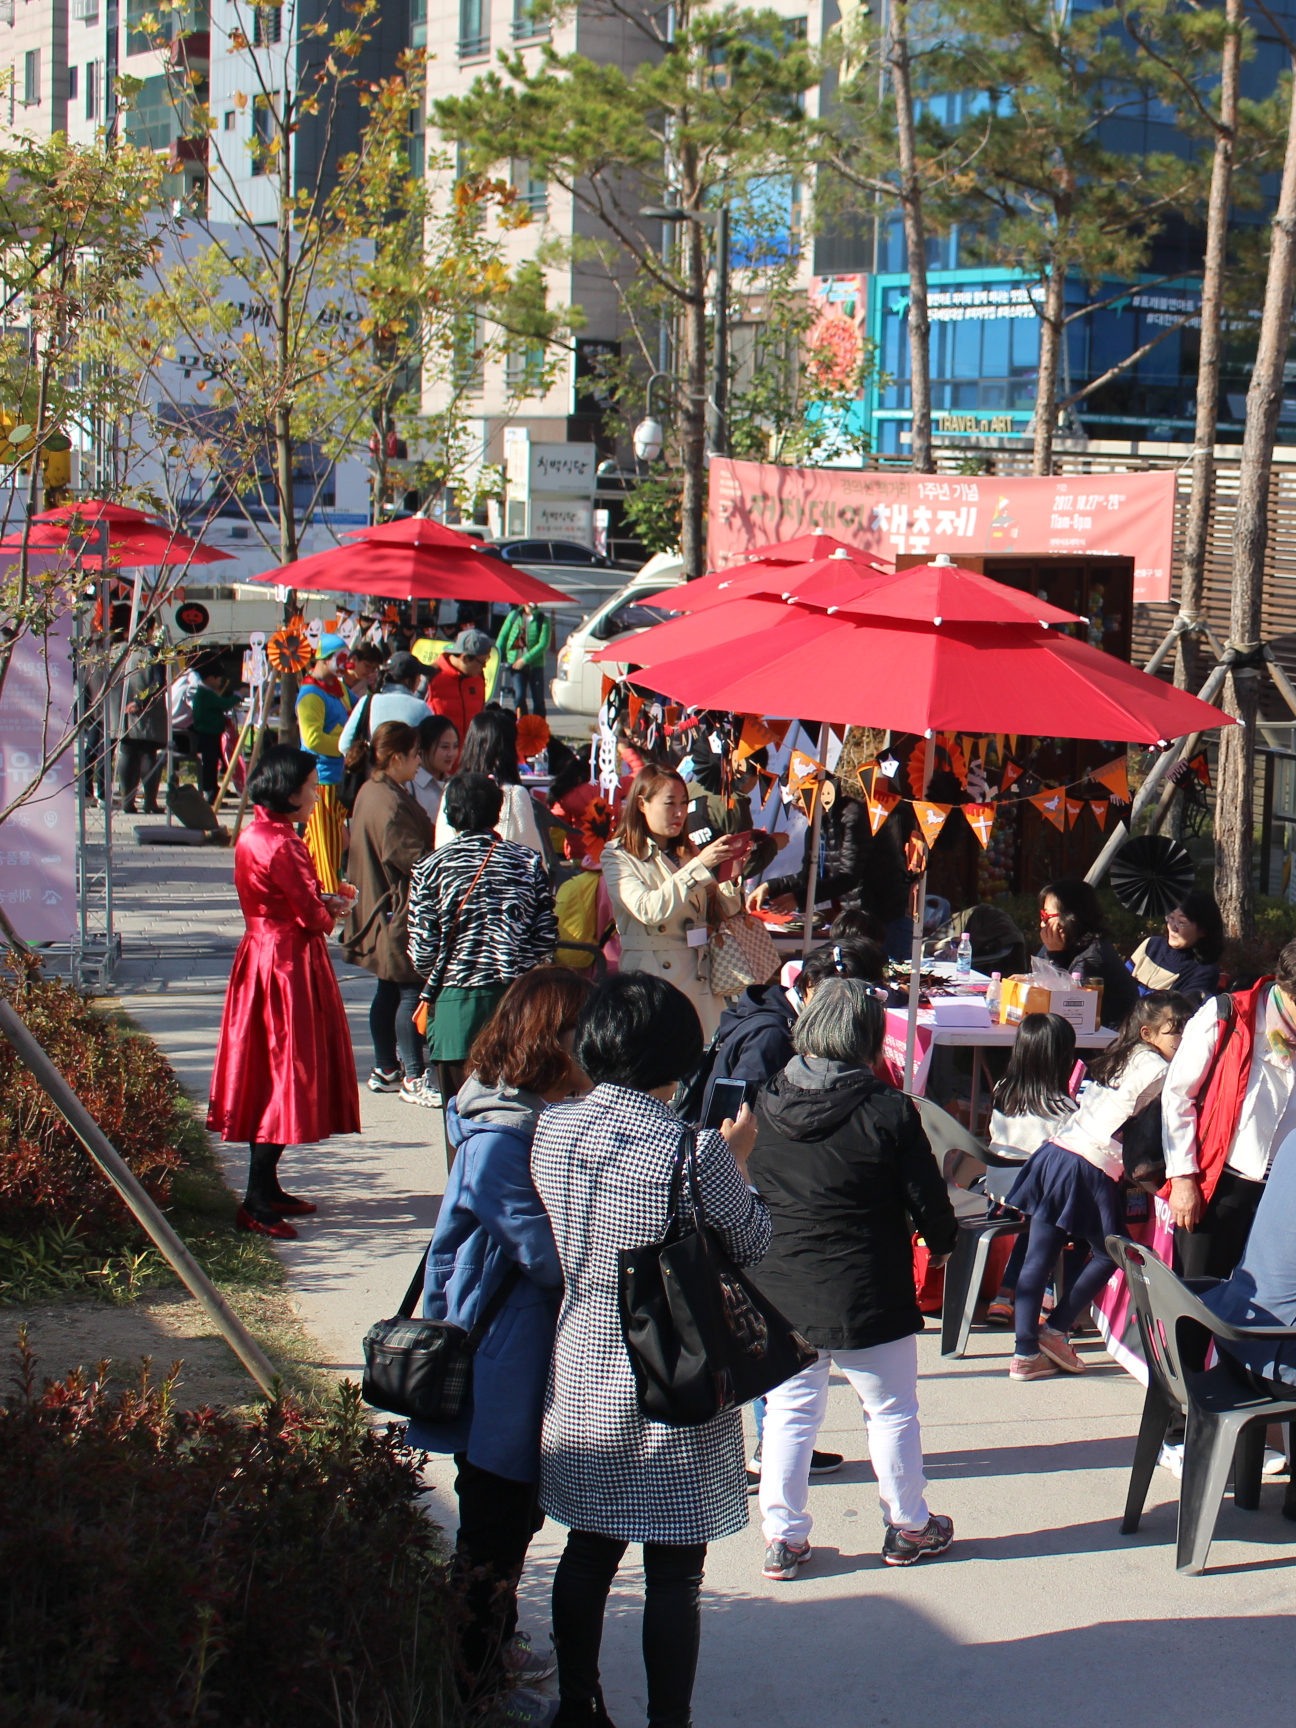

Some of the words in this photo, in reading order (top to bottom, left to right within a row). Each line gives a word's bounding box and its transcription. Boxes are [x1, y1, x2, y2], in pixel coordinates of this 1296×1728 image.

[938, 415, 978, 432] TRAVEL
[989, 415, 1014, 433] ART
[917, 482, 951, 501] 1주년
[952, 483, 979, 502] 기념
[870, 502, 978, 555] 책축제
